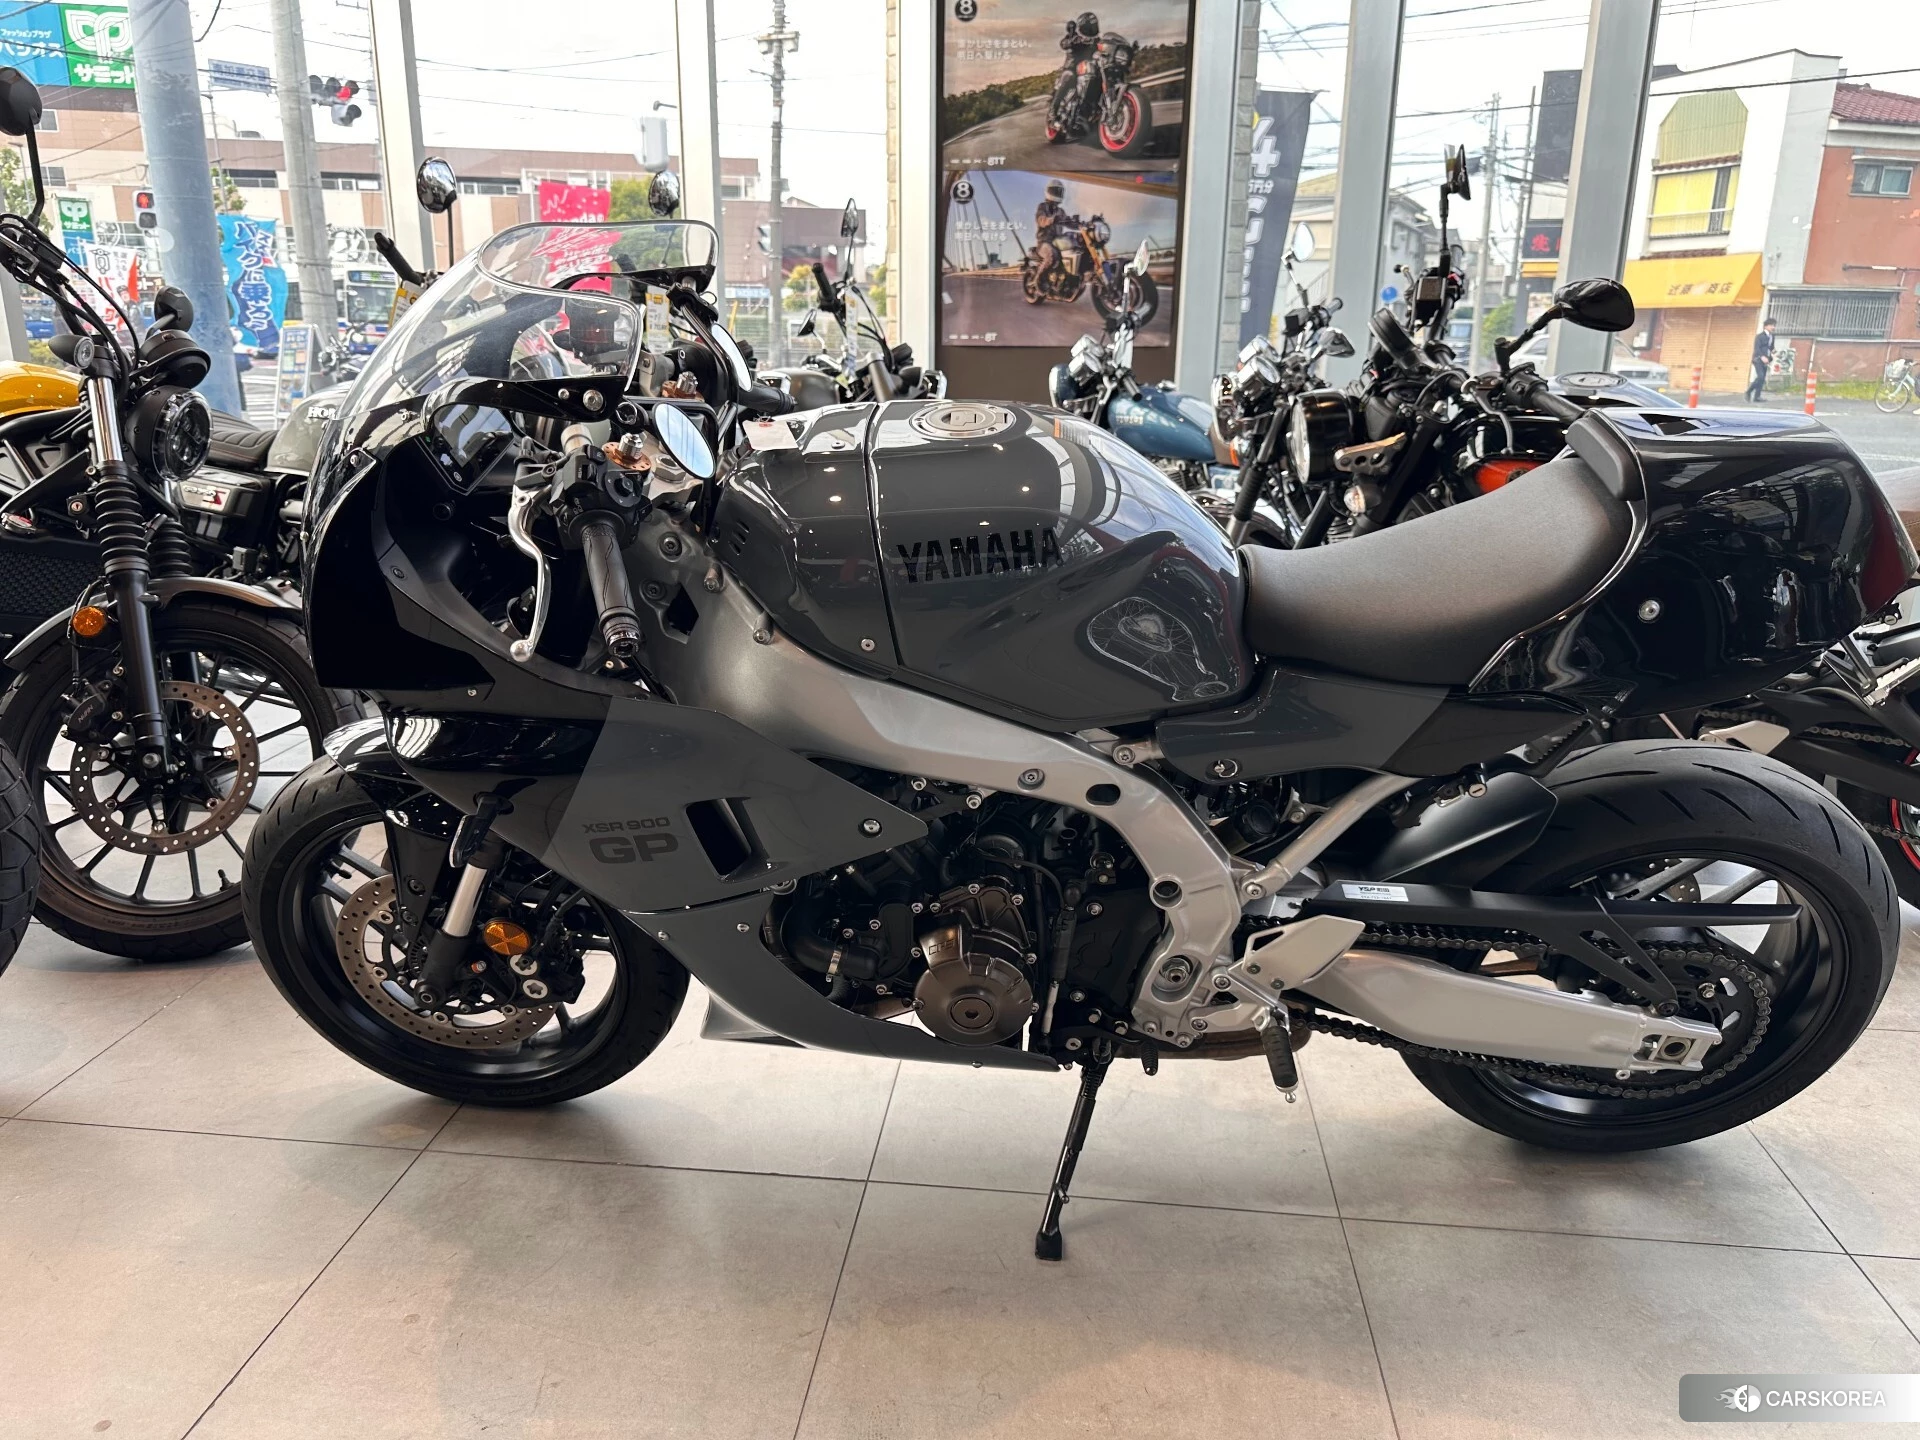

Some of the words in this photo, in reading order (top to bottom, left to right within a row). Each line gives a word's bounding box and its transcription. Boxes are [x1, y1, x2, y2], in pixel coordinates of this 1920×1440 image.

[959, 0, 974, 15] 8
[74, 63, 135, 84] サミット
[956, 182, 971, 198] 8
[896, 527, 1063, 584] YAMAHA
[582, 820, 625, 834] XSR
[627, 816, 672, 830] 900
[588, 832, 680, 864] GP
